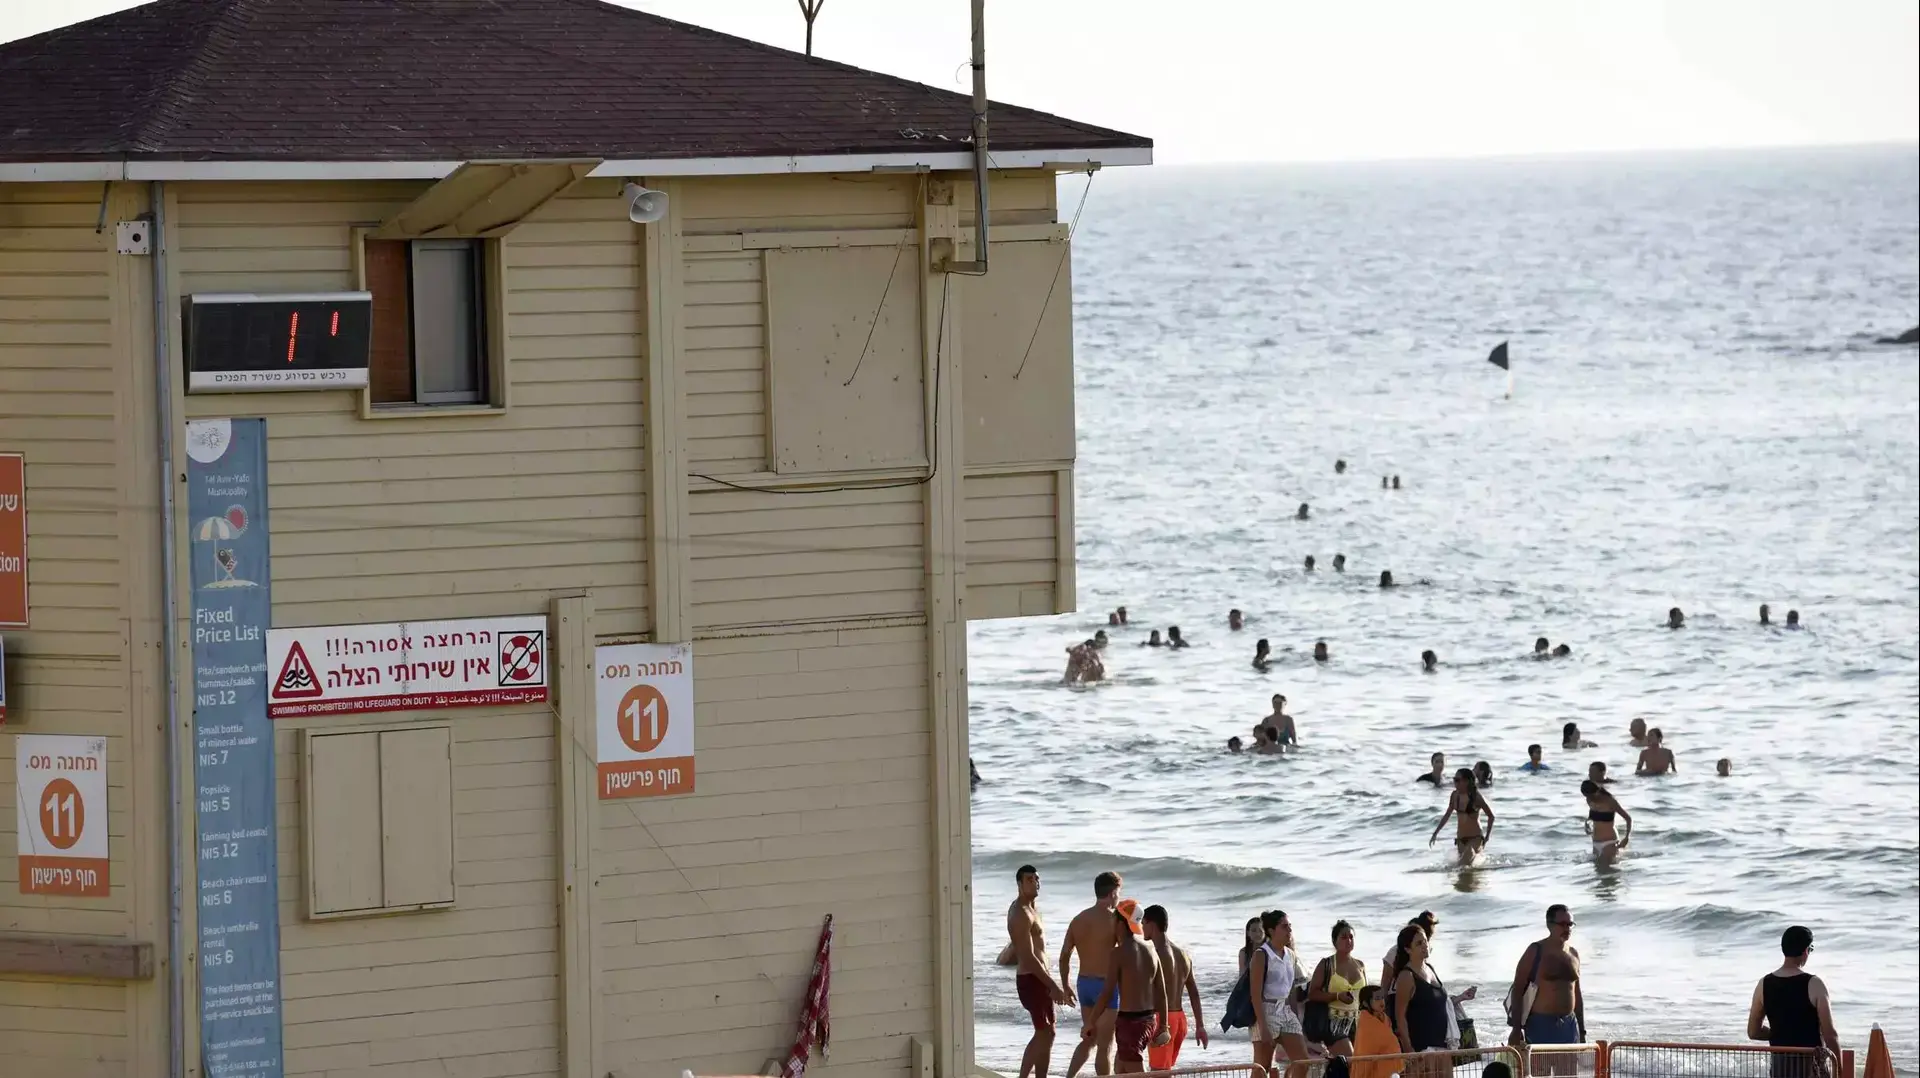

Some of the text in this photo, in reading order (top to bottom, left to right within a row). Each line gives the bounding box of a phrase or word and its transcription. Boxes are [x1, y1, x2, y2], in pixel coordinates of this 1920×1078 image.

[215, 371, 346, 382] נרכש בסיוע משרד הפנים
[196, 605, 234, 624] Fixed
[196, 625, 260, 643] Price List
[424, 631, 491, 648] הרחצה
[327, 657, 491, 688] אין שירותי הצלה
[600, 661, 683, 679] תחנה מס.
[197, 690, 237, 706] NIS 12
[272, 705, 307, 715] SWIMMING
[354, 700, 364, 709] NO
[365, 698, 401, 709] LIFEGUARD
[402, 698, 412, 706] ON
[413, 697, 432, 705] DUTY
[625, 698, 659, 741] 11
[198, 724, 243, 735] Small bottle
[199, 736, 258, 748] of mineral water
[25, 755, 97, 771] תחנה מס.
[199, 750, 228, 766] NIS 7
[607, 768, 681, 794] חוף פרישמן
[200, 785, 231, 796] Popsicle
[200, 796, 230, 812] NIS 5
[46, 793, 75, 837] 11
[202, 831, 231, 842] Tanning
[202, 843, 238, 860] NIS 12
[31, 867, 97, 891] חוף פרישמן
[202, 878, 225, 889] Beach
[226, 876, 244, 886] chair
[202, 890, 232, 906] NIS 6
[203, 925, 225, 935] Beach
[204, 949, 234, 966] NIS 6
